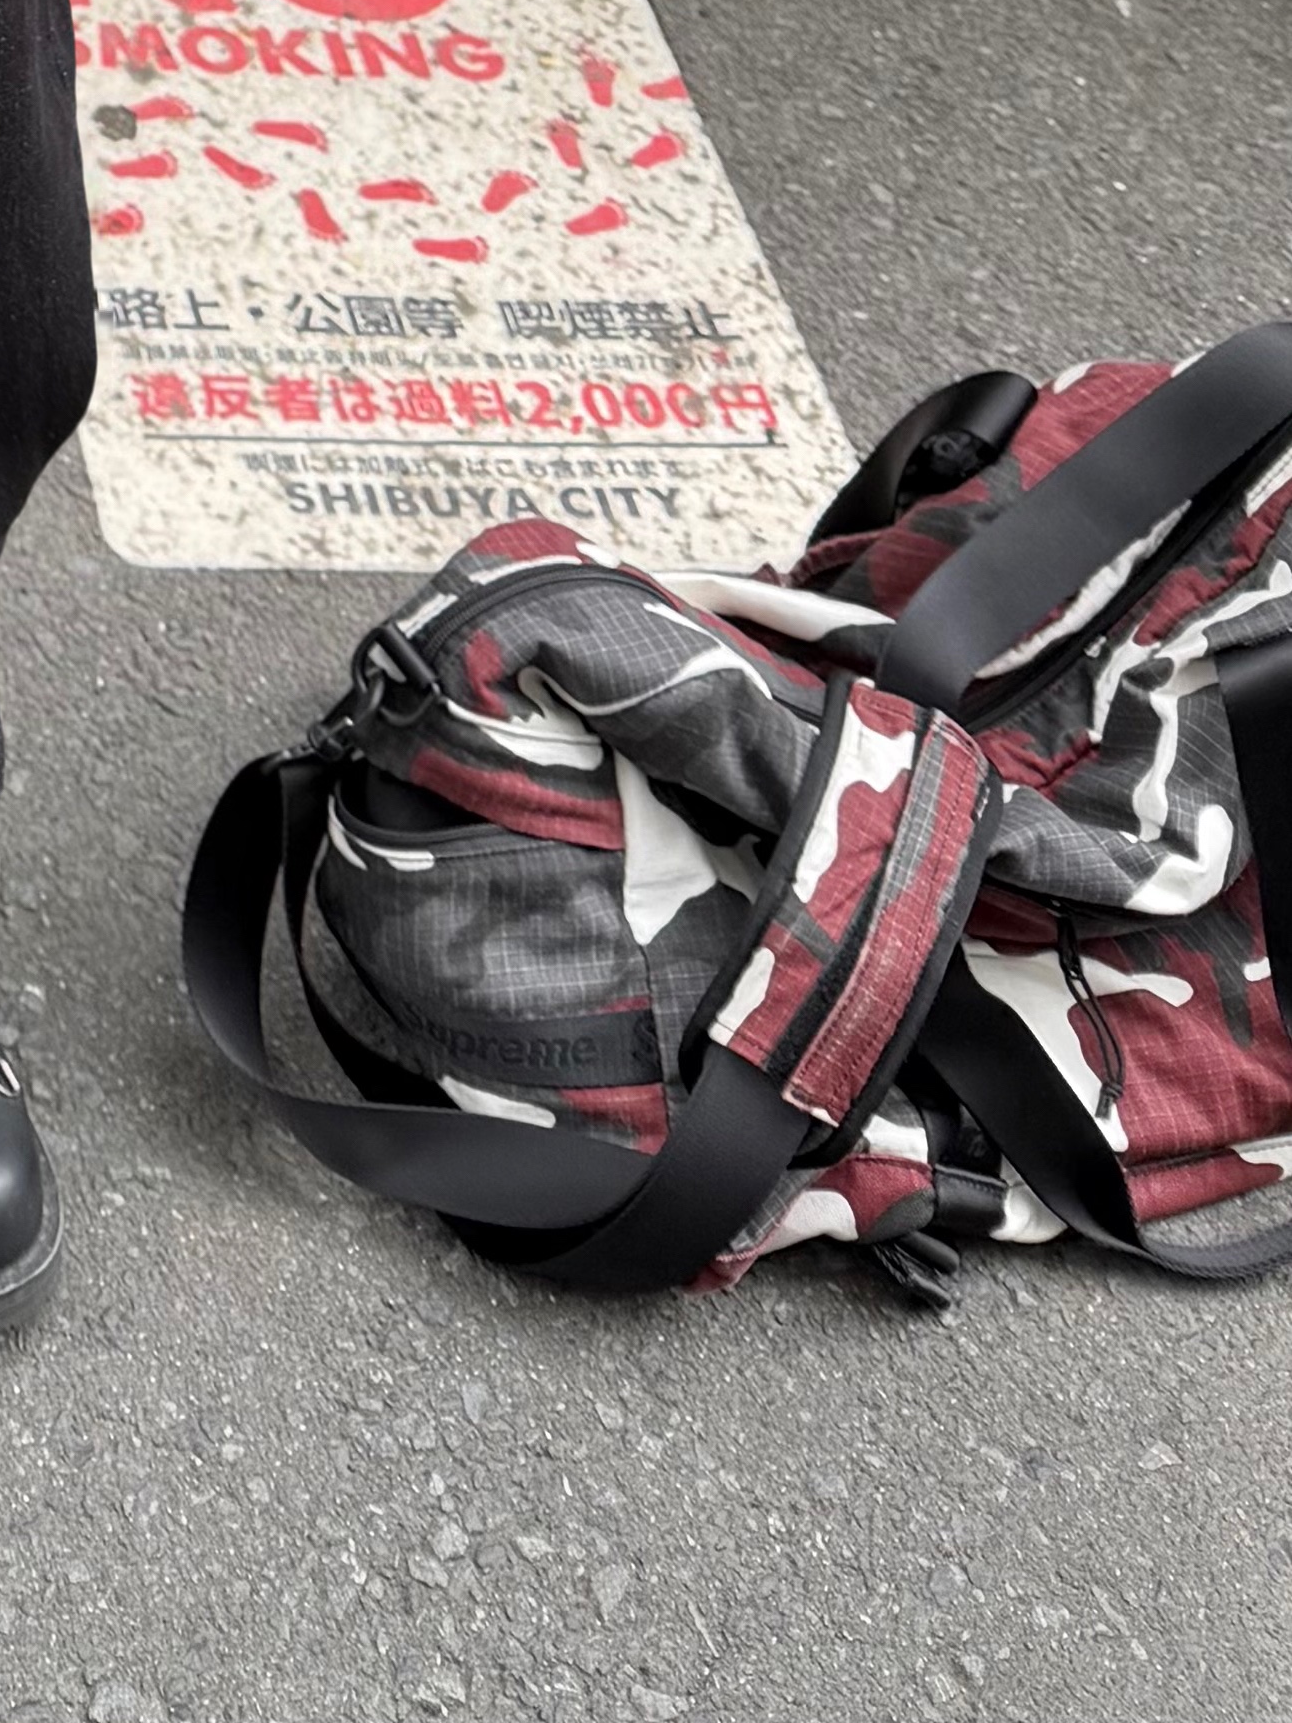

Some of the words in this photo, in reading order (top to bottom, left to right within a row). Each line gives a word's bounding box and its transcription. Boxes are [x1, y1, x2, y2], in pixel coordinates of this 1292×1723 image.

[498, 298, 743, 342] 喫煙禁止
[285, 481, 543, 518] SHIBUYA
[558, 485, 682, 520] CITY
